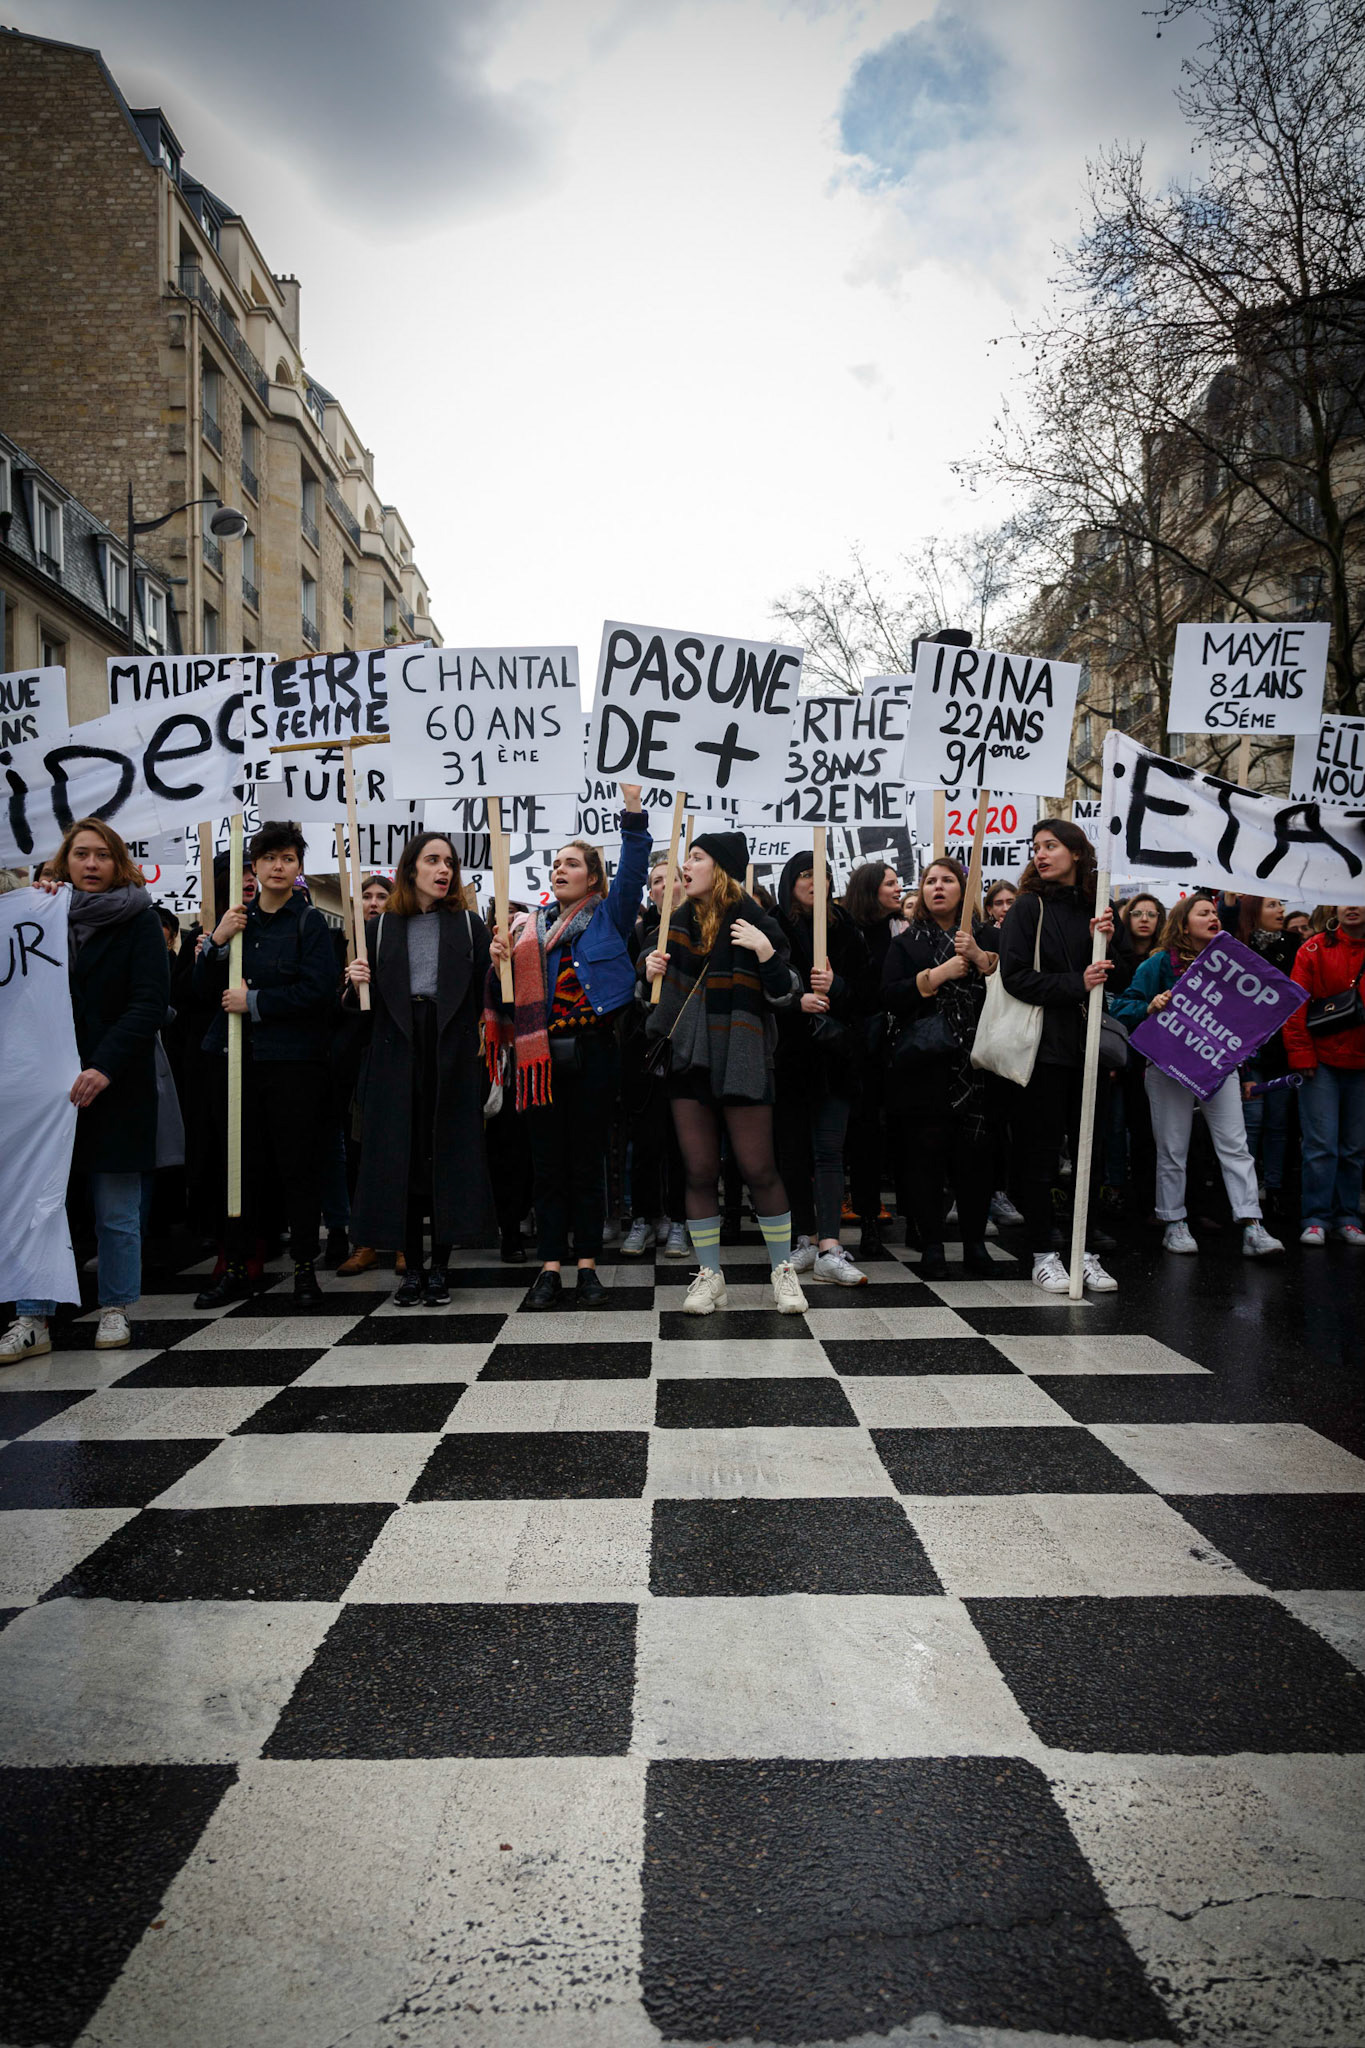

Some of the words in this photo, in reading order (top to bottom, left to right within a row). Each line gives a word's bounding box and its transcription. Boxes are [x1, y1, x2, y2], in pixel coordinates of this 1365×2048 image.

[402, 655, 577, 693] CHANTAL
[933, 647, 1053, 708] IRINA
[275, 700, 390, 742] FEMME
[426, 704, 475, 741] 60
[487, 704, 562, 740] ANS
[597, 704, 681, 781] DE
[788, 698, 908, 747] RTHE
[284, 765, 386, 804] TUER
[948, 804, 1018, 837] 2020
[1186, 970, 1203, 991] à
[1201, 980, 1223, 1007] la
[1203, 949, 1280, 1006] STOP
[1156, 1010, 1185, 1037] du
[1183, 1031, 1226, 1071] viol.
[1172, 993, 1243, 1052] culture
